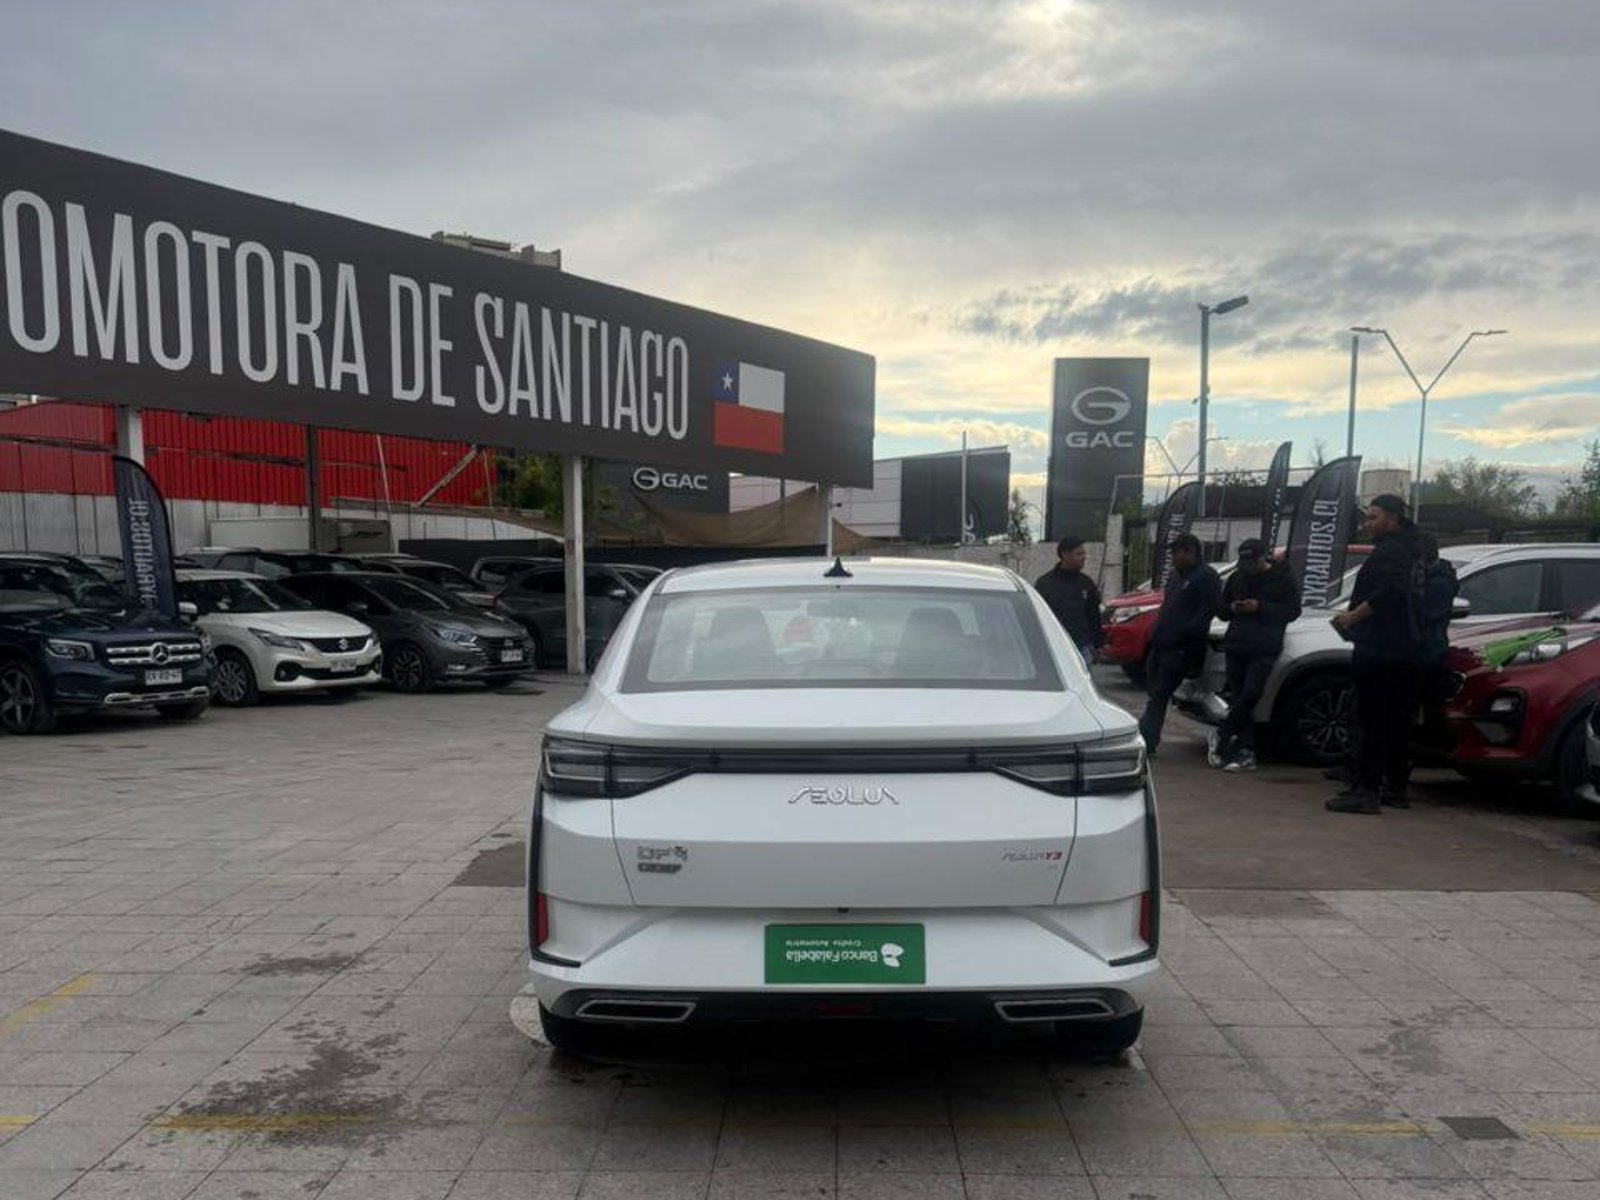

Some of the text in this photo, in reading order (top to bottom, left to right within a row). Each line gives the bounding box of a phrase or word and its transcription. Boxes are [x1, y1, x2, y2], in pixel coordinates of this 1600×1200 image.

[389, 272, 455, 407] DE
[474, 291, 690, 441] SANTIAGO
[1064, 430, 1135, 449] GAC
[661, 474, 709, 491] GAC
[786, 949, 878, 964] Banco Falabella
